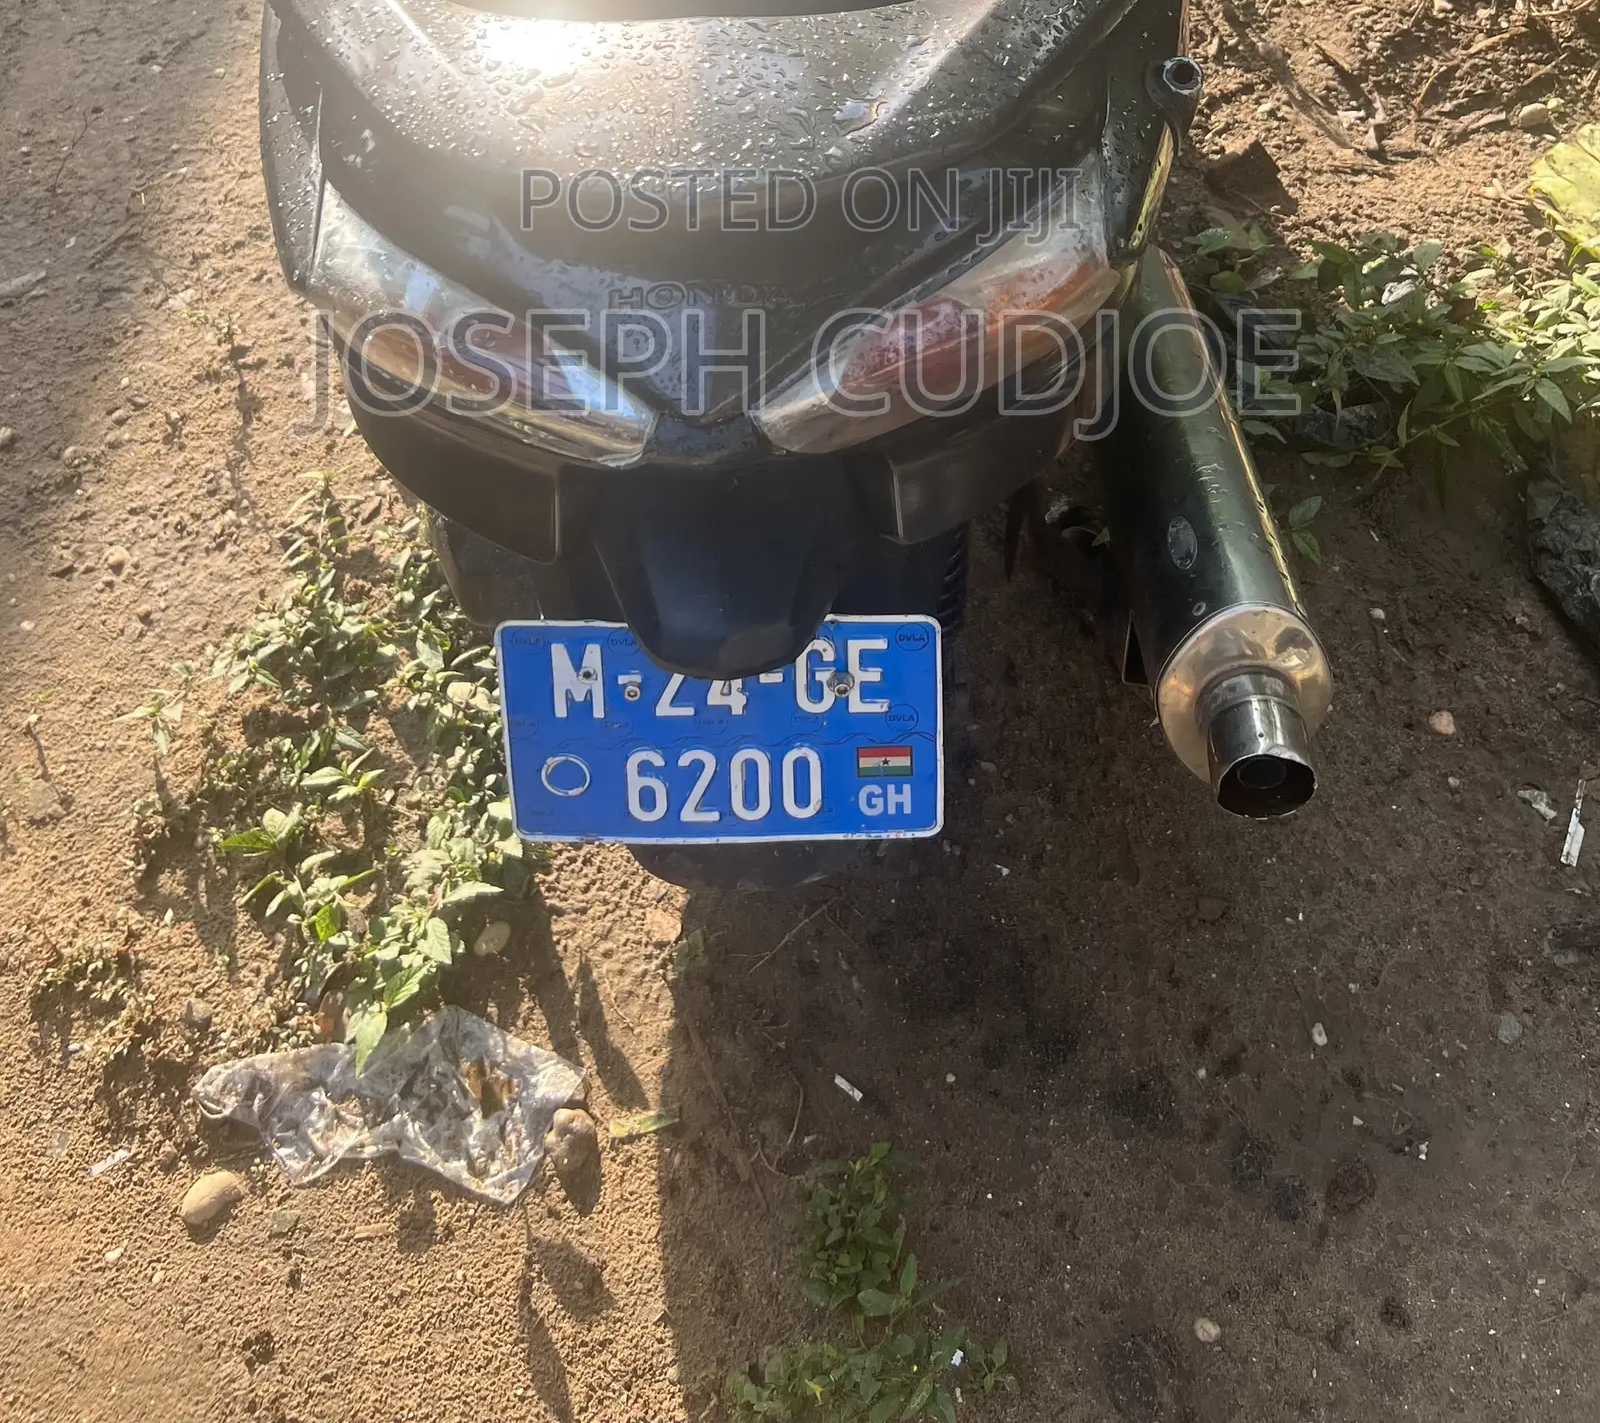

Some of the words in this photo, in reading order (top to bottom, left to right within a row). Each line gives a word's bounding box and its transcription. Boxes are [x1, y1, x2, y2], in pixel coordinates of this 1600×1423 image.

[608, 280, 804, 310] HONDA
[625, 746, 823, 822] 6200
[858, 784, 912, 817] GH
